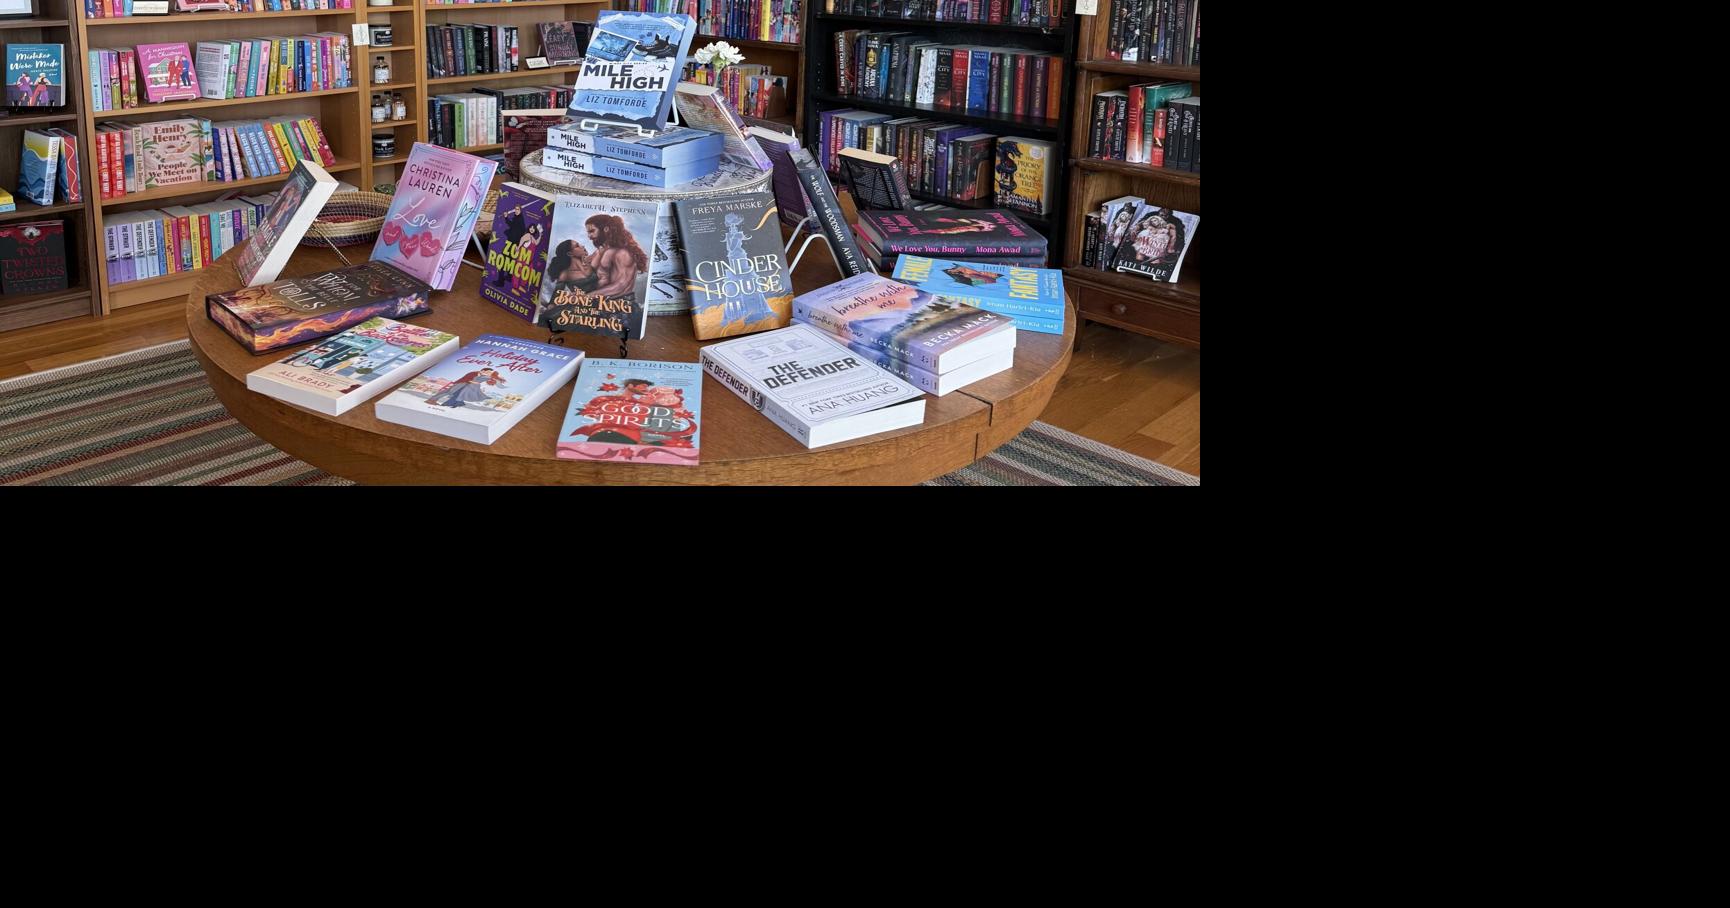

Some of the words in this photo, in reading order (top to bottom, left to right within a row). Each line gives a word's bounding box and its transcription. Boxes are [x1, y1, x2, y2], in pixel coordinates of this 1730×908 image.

[16, 52, 51, 61] Mistakes
[10, 62, 32, 70] Were
[35, 59, 60, 68] Made
[584, 65, 634, 77] MILE
[610, 77, 664, 89] HIGH
[586, 95, 602, 104] LIZ
[602, 97, 647, 108] TOMFORDE
[154, 124, 186, 135] Emily
[153, 133, 187, 143] Henry
[560, 133, 579, 142] MILE
[566, 140, 586, 149] HIGH
[557, 153, 577, 163] MILE
[606, 145, 615, 153] LIZ
[616, 146, 646, 159] TOMFORDE
[157, 162, 188, 171] People
[563, 160, 585, 170] HIGH
[1018, 160, 1041, 169] PRIORY
[155, 175, 193, 184] Vacation
[409, 163, 460, 188] CHRISTINA
[616, 167, 648, 180] TOMFORDE
[408, 178, 452, 199] LAUREN
[393, 197, 440, 228] Love
[564, 201, 607, 212] ELIZABETH
[610, 205, 647, 215] STEPHENS
[692, 204, 723, 215] FREYA
[725, 200, 764, 213] MARSKE
[812, 180, 824, 197] WOLF
[825, 208, 846, 243] WOODSMAN
[842, 247, 853, 260] AVA
[849, 260, 862, 276] REID
[502, 240, 533, 265] ZOM
[891, 245, 904, 253] We
[905, 245, 922, 253] Love
[924, 245, 940, 254] You,
[941, 246, 966, 255] Bunny
[999, 245, 1021, 253] Awad
[4, 266, 65, 279] CROWNS
[488, 250, 541, 287] ROMCOM
[696, 253, 782, 283] CINDER
[1118, 260, 1137, 269] KATI
[1140, 264, 1167, 276] WILDE
[704, 274, 783, 301] HOUSE
[1008, 267, 1040, 300] FANTASY
[272, 281, 326, 311] TOLLS
[484, 289, 509, 307] OLIVIA
[509, 301, 529, 316] DADE
[554, 290, 594, 308] BONE
[597, 294, 632, 314] KING
[832, 294, 878, 317] breathe
[879, 284, 908, 299] with
[879, 298, 896, 309] me
[557, 310, 623, 332] STARLING
[807, 312, 832, 326] breathe
[833, 320, 848, 332] with
[850, 329, 863, 339] me
[869, 337, 893, 350] BECKA
[894, 347, 915, 358] MACK
[923, 327, 962, 348] BECKA
[963, 313, 997, 331] MACK
[475, 339, 528, 352] HANNAH
[531, 349, 570, 360] GRACE
[480, 349, 538, 364] Holiday
[456, 355, 493, 367] Ever
[496, 361, 543, 374] After
[628, 361, 694, 370] BORISON
[768, 361, 801, 378] THE
[278, 370, 295, 379] ALI
[297, 375, 335, 390] BRADY
[701, 354, 714, 369] THE
[714, 365, 749, 397] DEFENDER
[763, 357, 860, 390] DEFENDER
[894, 369, 915, 381] MACK
[809, 401, 842, 414] ANA
[842, 385, 899, 404] HUANG
[602, 402, 670, 417] GOOD
[583, 413, 687, 429] SPIRITS
